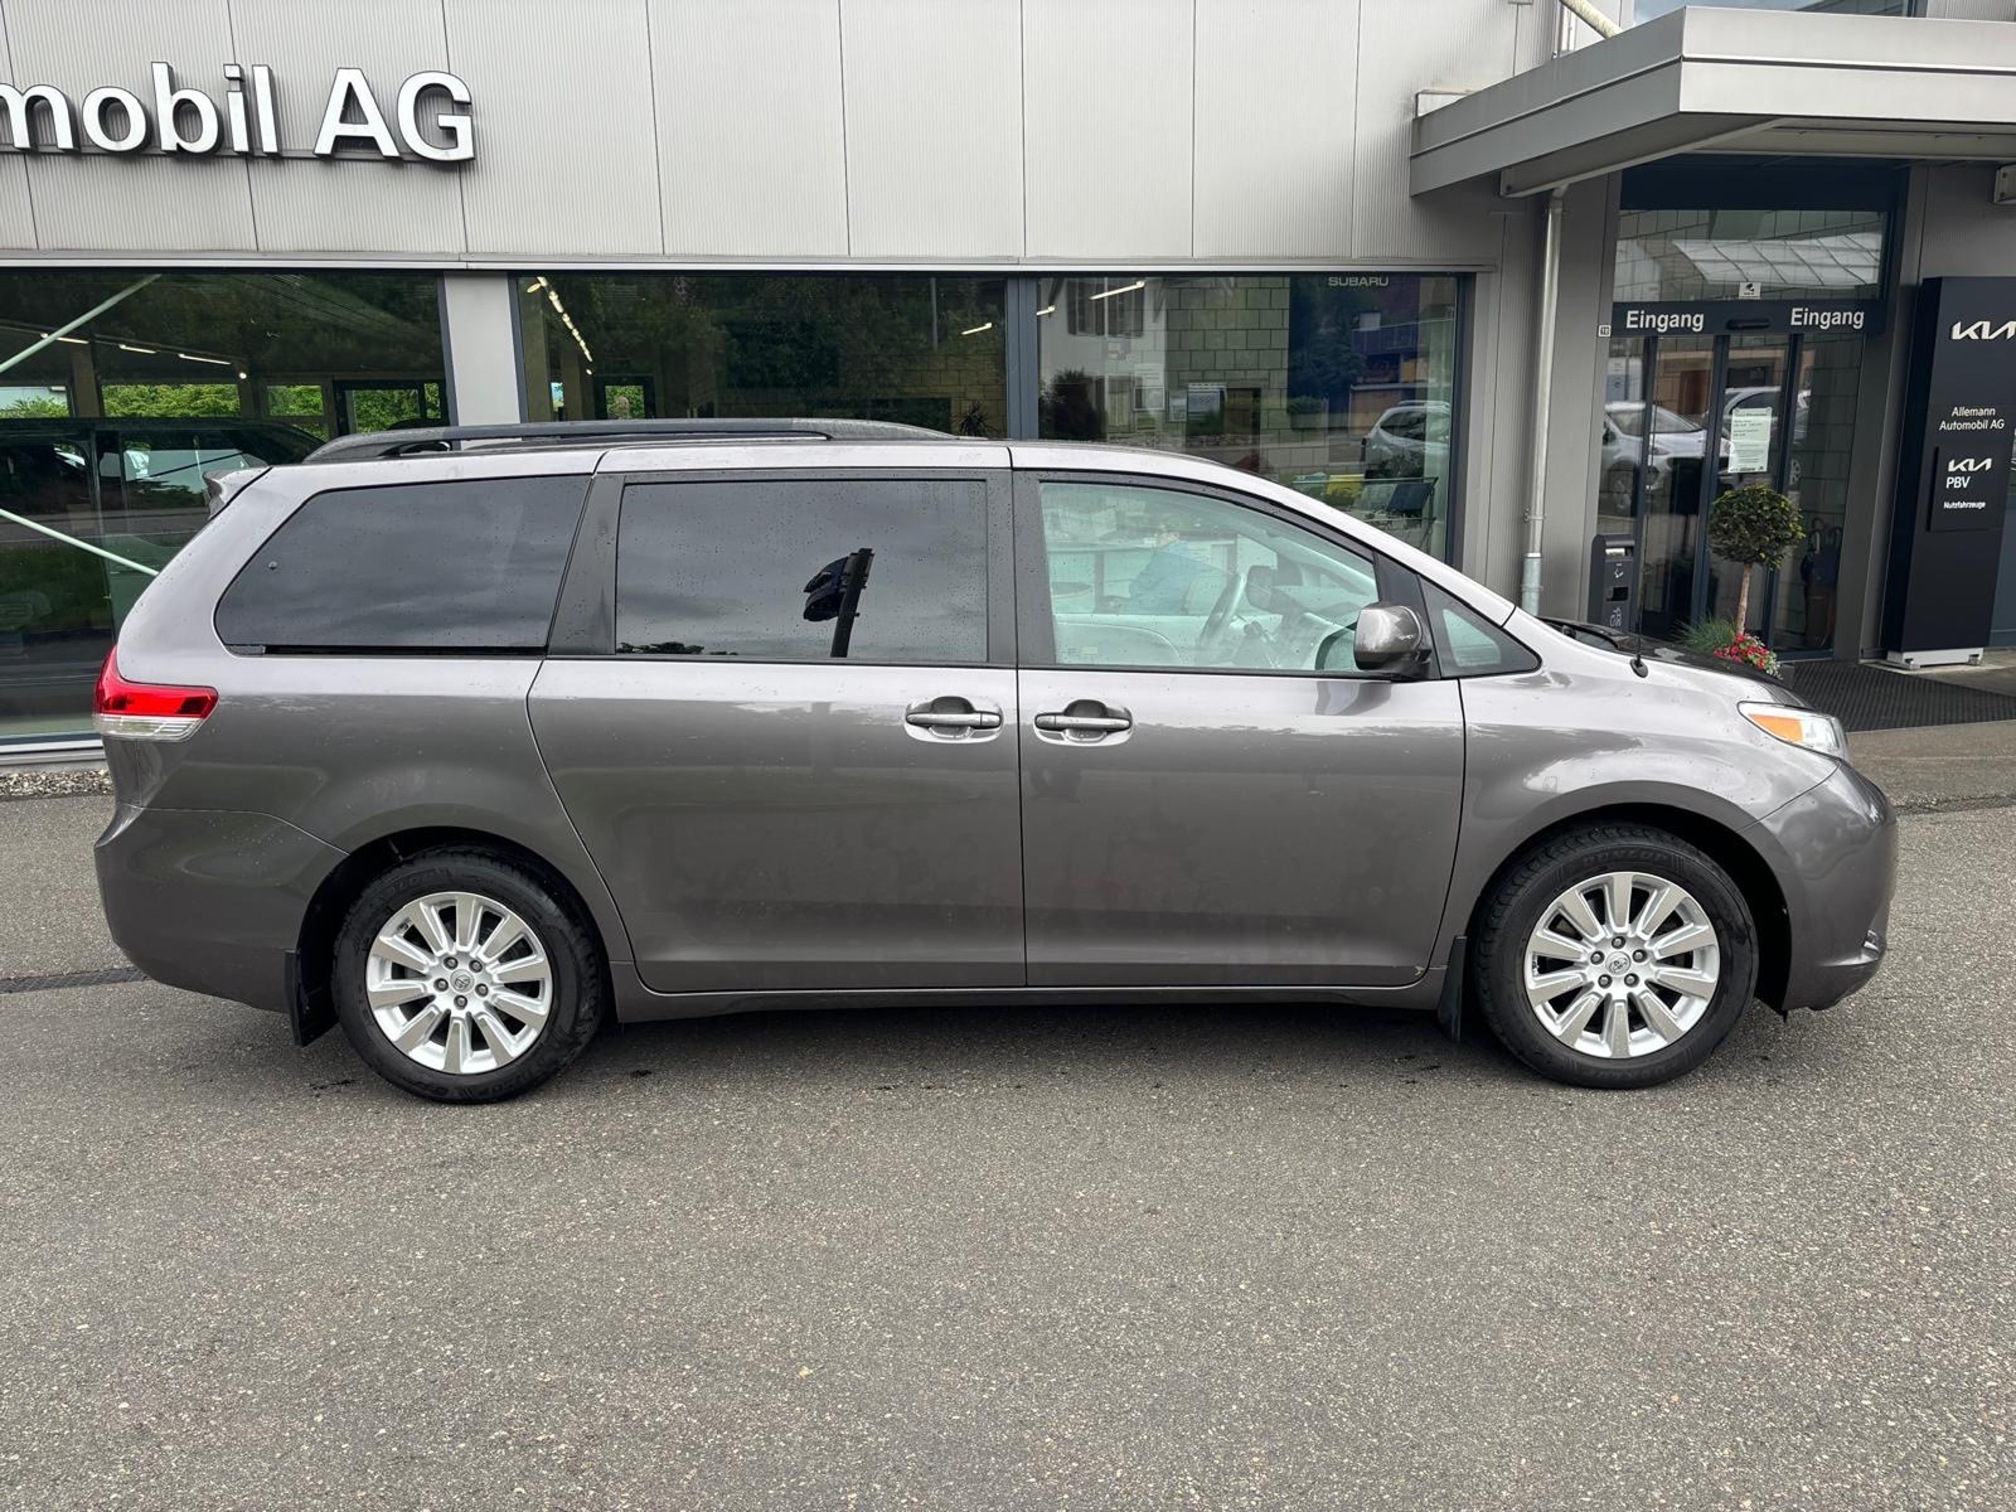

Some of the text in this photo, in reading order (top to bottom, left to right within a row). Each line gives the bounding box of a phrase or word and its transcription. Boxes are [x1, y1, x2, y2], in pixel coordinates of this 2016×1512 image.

[0, 61, 475, 161] mobil AG
[1328, 276, 1389, 287] SUBARU
[1626, 310, 1704, 332] Eingang
[1790, 308, 1865, 329] Eingang
[1952, 320, 2016, 340] KIA
[1951, 406, 1996, 417] Allemann
[1939, 419, 2005, 431] Automobil AG
[1948, 458, 1992, 472] KIA
[1946, 476, 1971, 489] PBV
